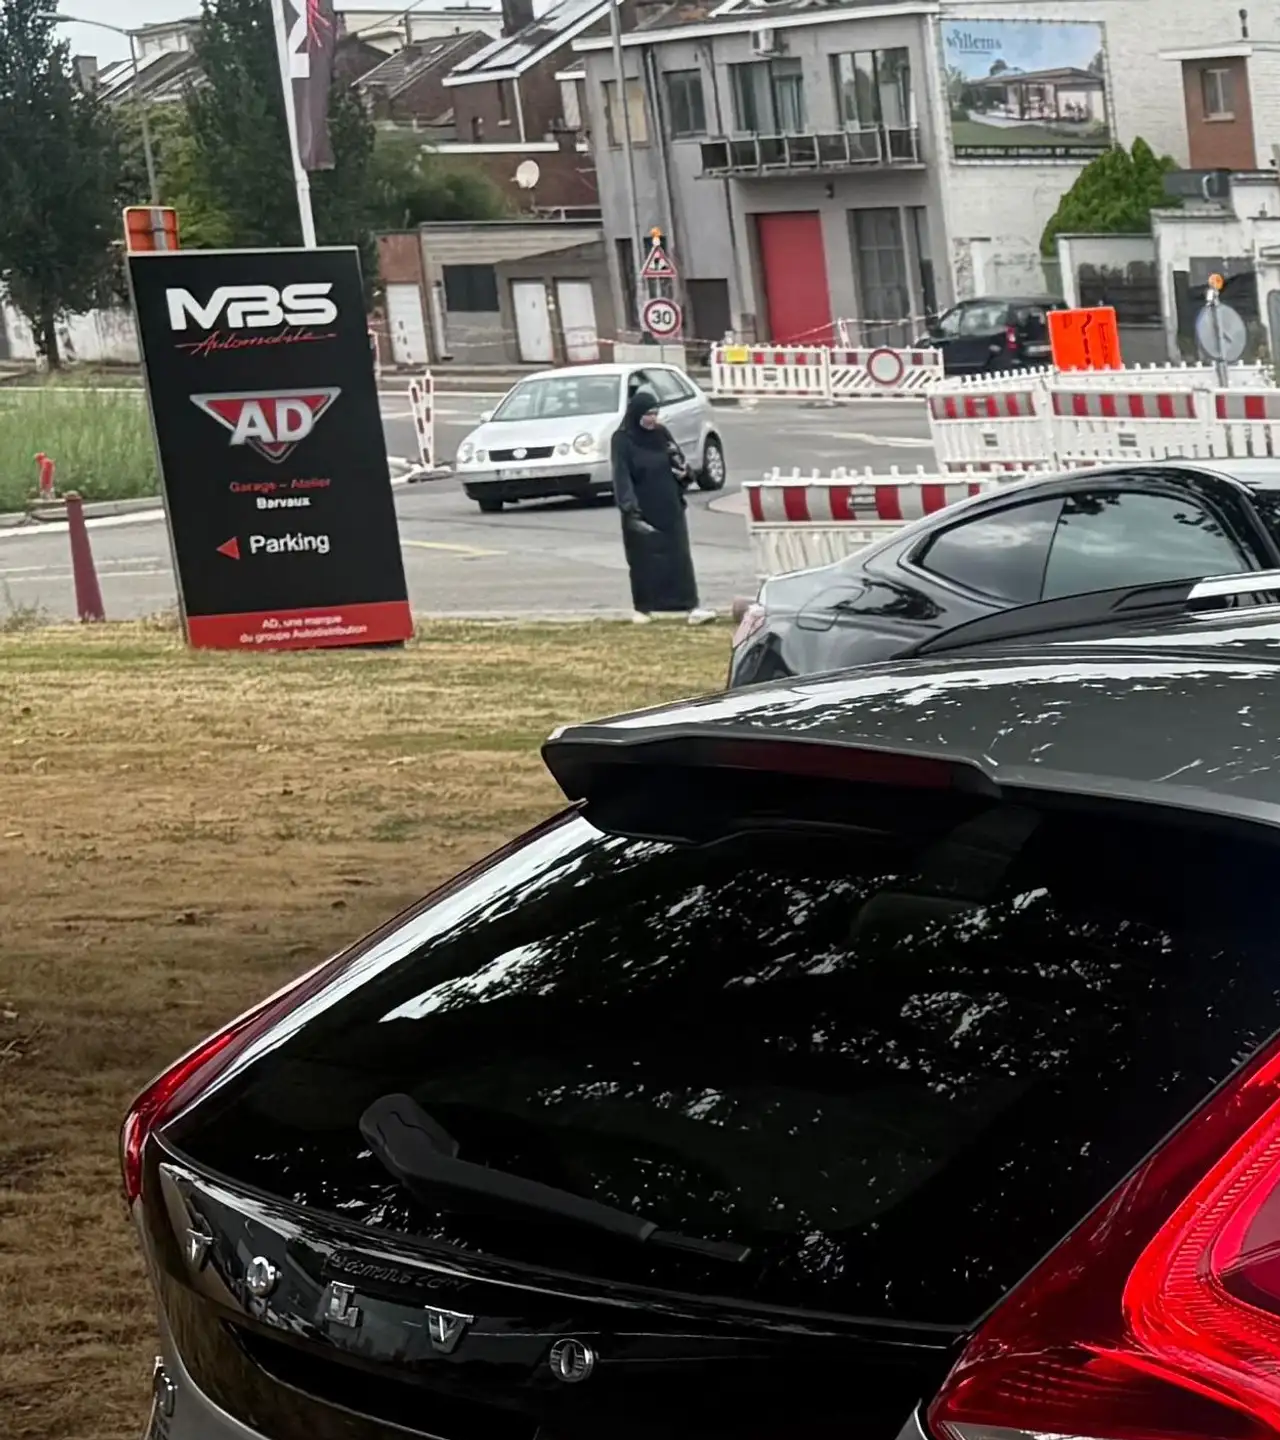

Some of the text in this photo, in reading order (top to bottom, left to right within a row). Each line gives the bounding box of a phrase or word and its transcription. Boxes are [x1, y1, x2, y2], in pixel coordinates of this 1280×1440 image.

[165, 283, 338, 331] MBS
[651, 310, 672, 325] 30
[229, 400, 314, 446] AD
[249, 532, 330, 554] Parking
